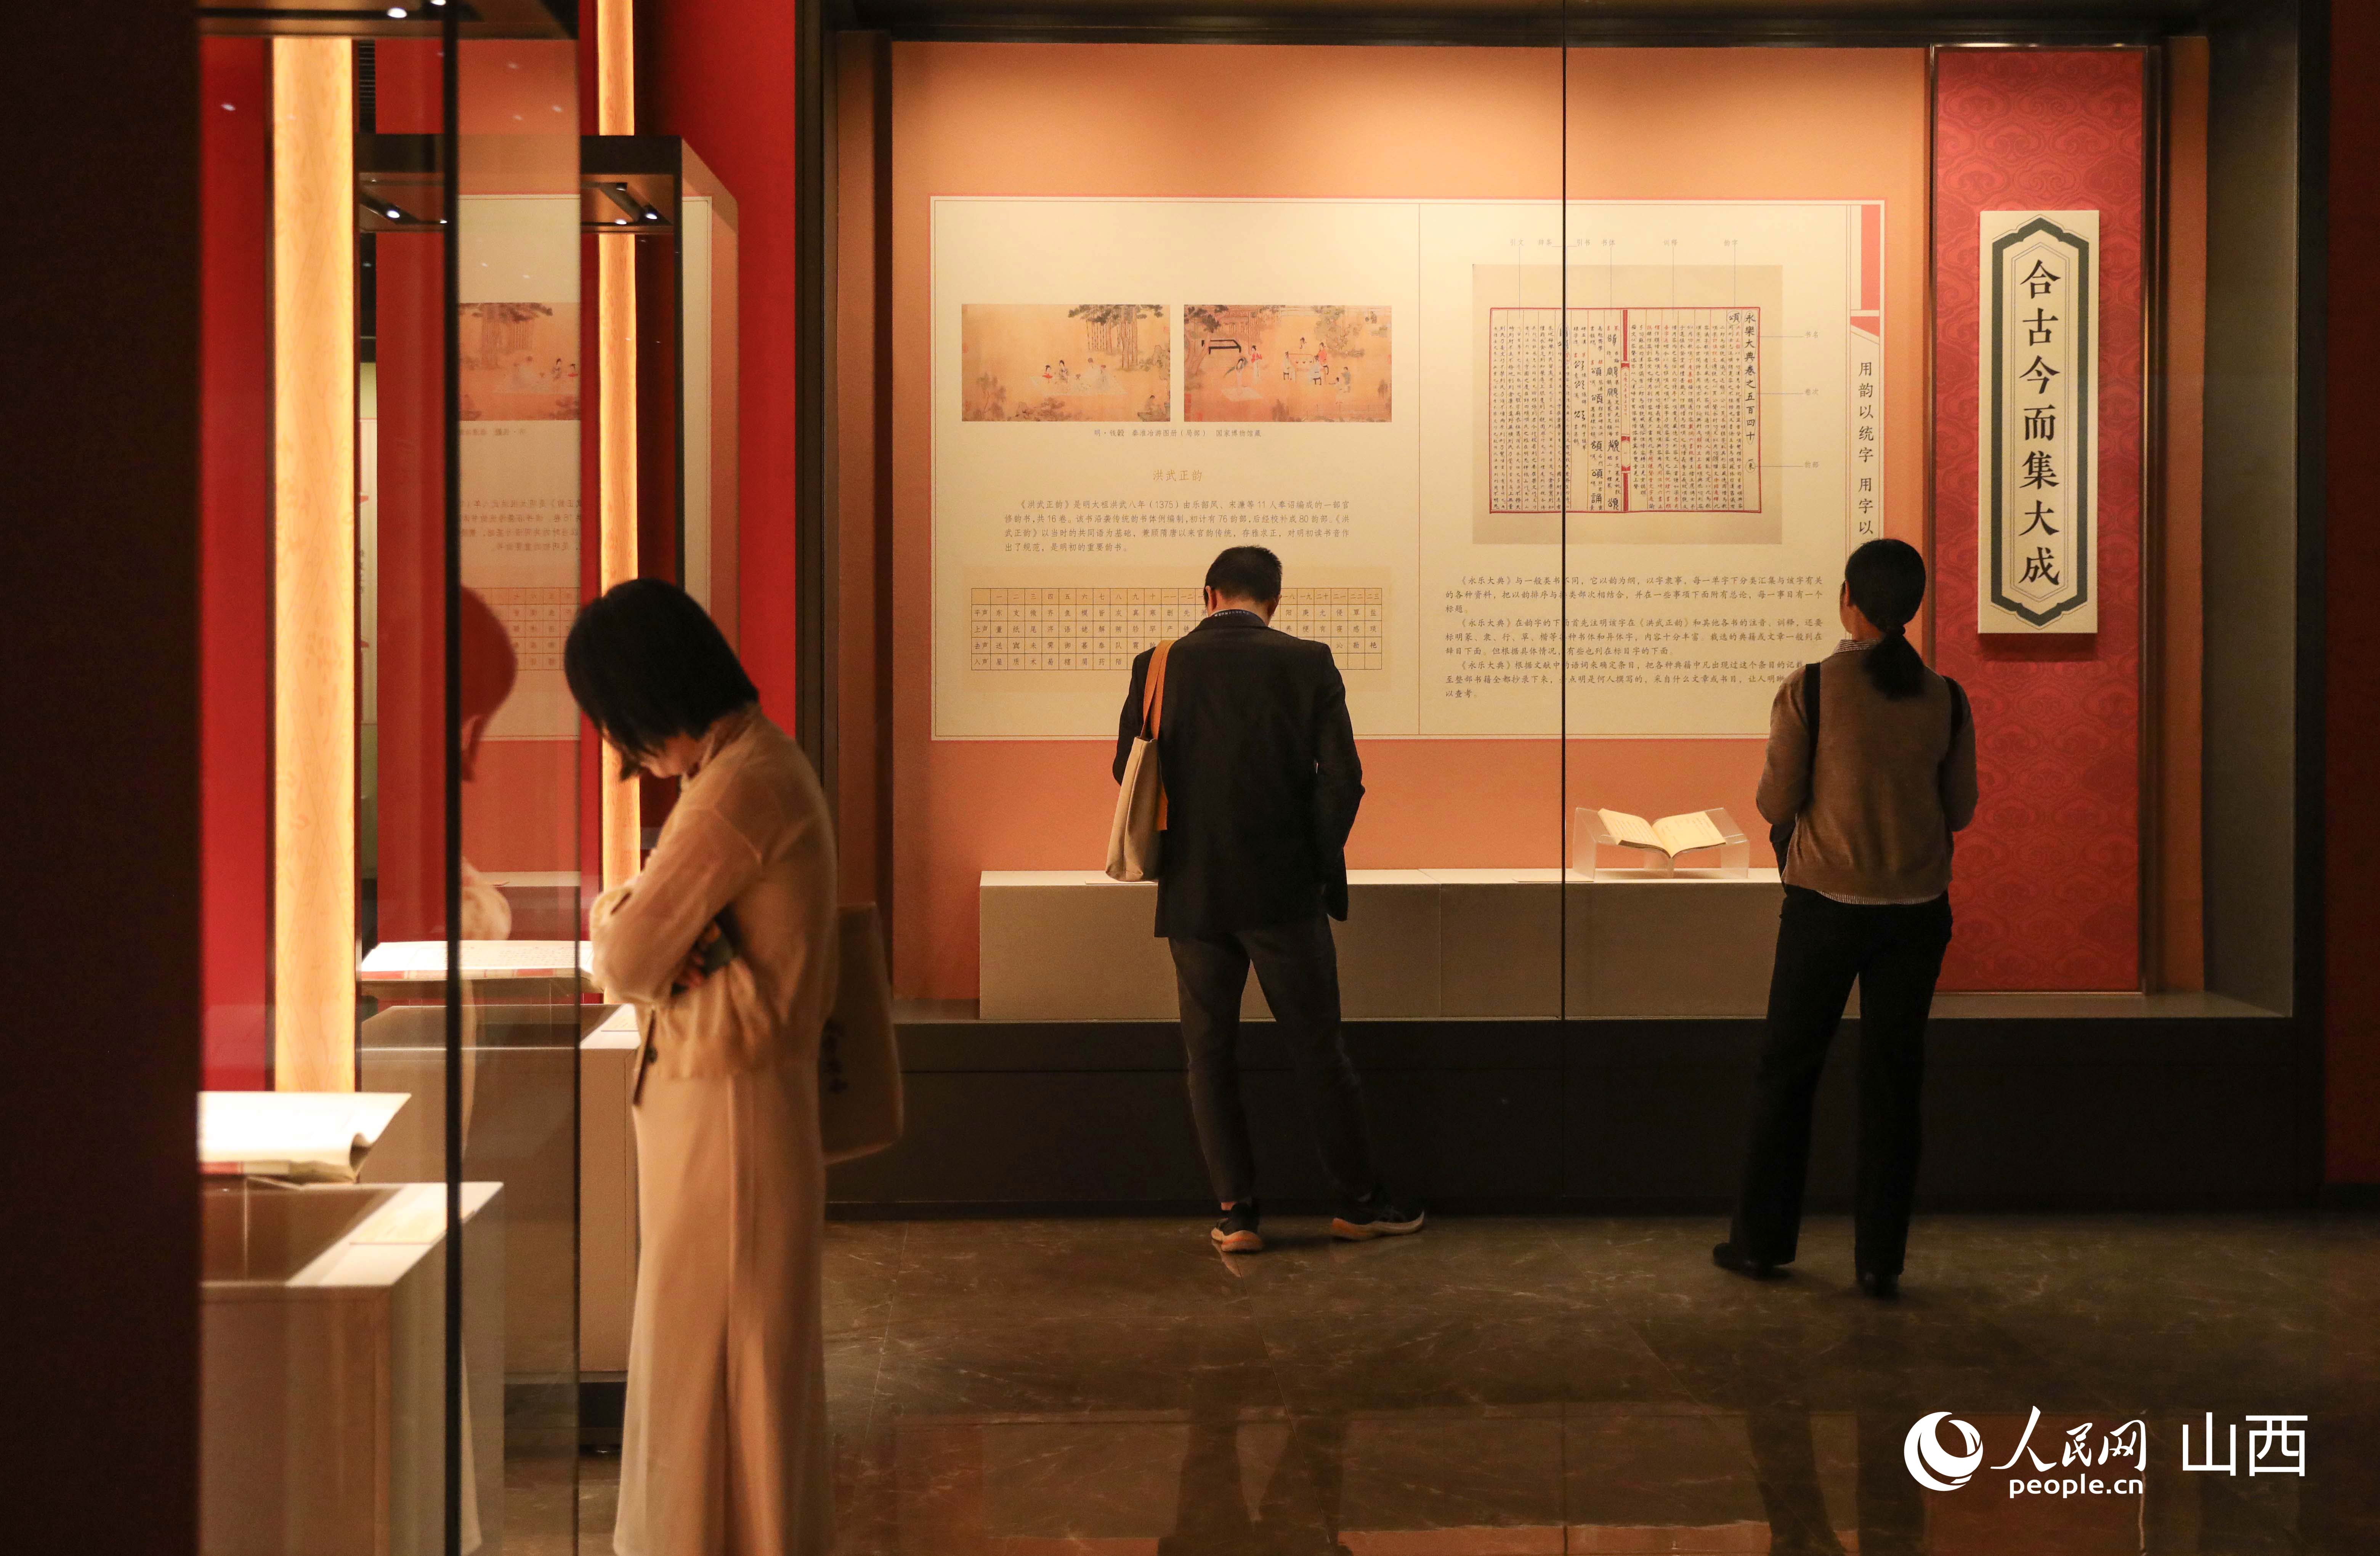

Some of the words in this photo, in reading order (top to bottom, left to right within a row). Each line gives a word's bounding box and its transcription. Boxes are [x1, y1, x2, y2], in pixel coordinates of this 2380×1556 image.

[1859, 362, 1873, 463] 用韵以统字
[2019, 260, 2061, 585] 合古今而集大成
[1153, 470, 1202, 481] 洪武正韵
[1859, 478, 1873, 545] 用字以
[1446, 605, 1467, 613] 标题。
[1446, 689, 1477, 698] 以查考。
